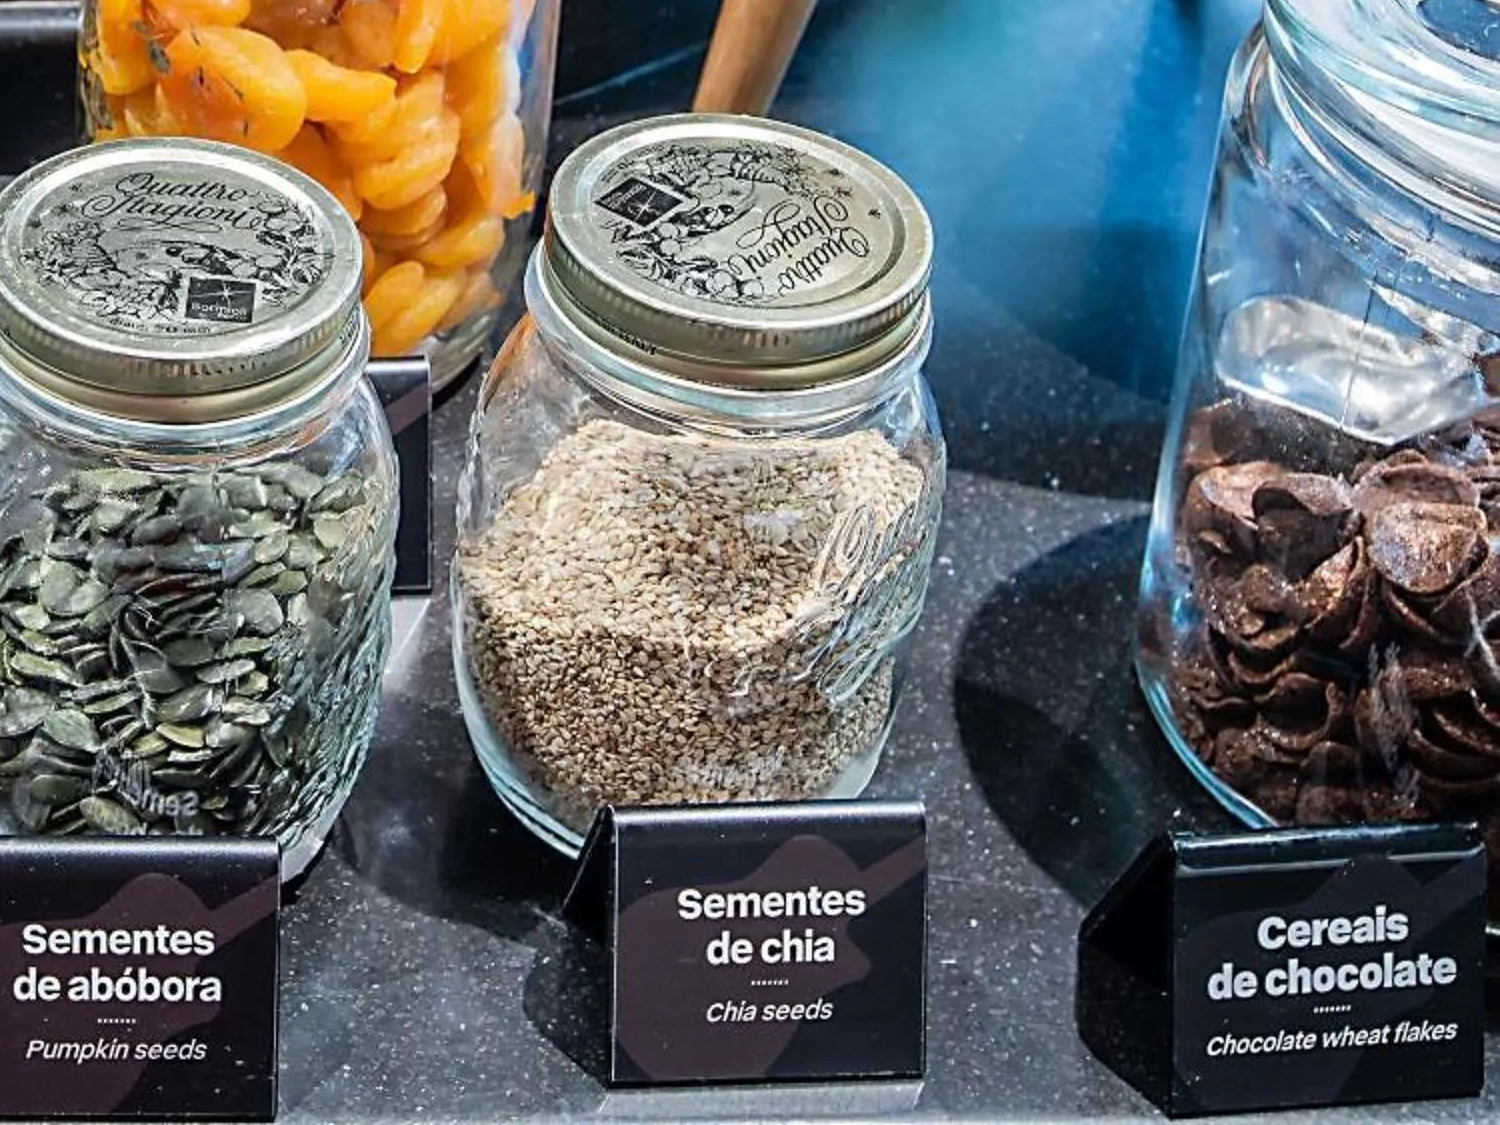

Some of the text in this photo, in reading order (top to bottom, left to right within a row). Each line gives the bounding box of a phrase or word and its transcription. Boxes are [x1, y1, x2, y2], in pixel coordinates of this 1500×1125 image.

[115, 172, 250, 202] Quattro
[81, 194, 262, 230] Stagioni
[677, 885, 867, 920] Sementes
[22, 924, 216, 956] Sementes
[1257, 904, 1409, 950] Cereais
[706, 928, 836, 966] de chia
[12, 966, 222, 1003] de abóbora
[1207, 952, 1458, 1000] de chocolate
[706, 998, 834, 1023] Chia seeds
[25, 1038, 208, 1065] Pumpkin seeds
[1206, 1019, 1459, 1056] Chocolate wheat flakes
